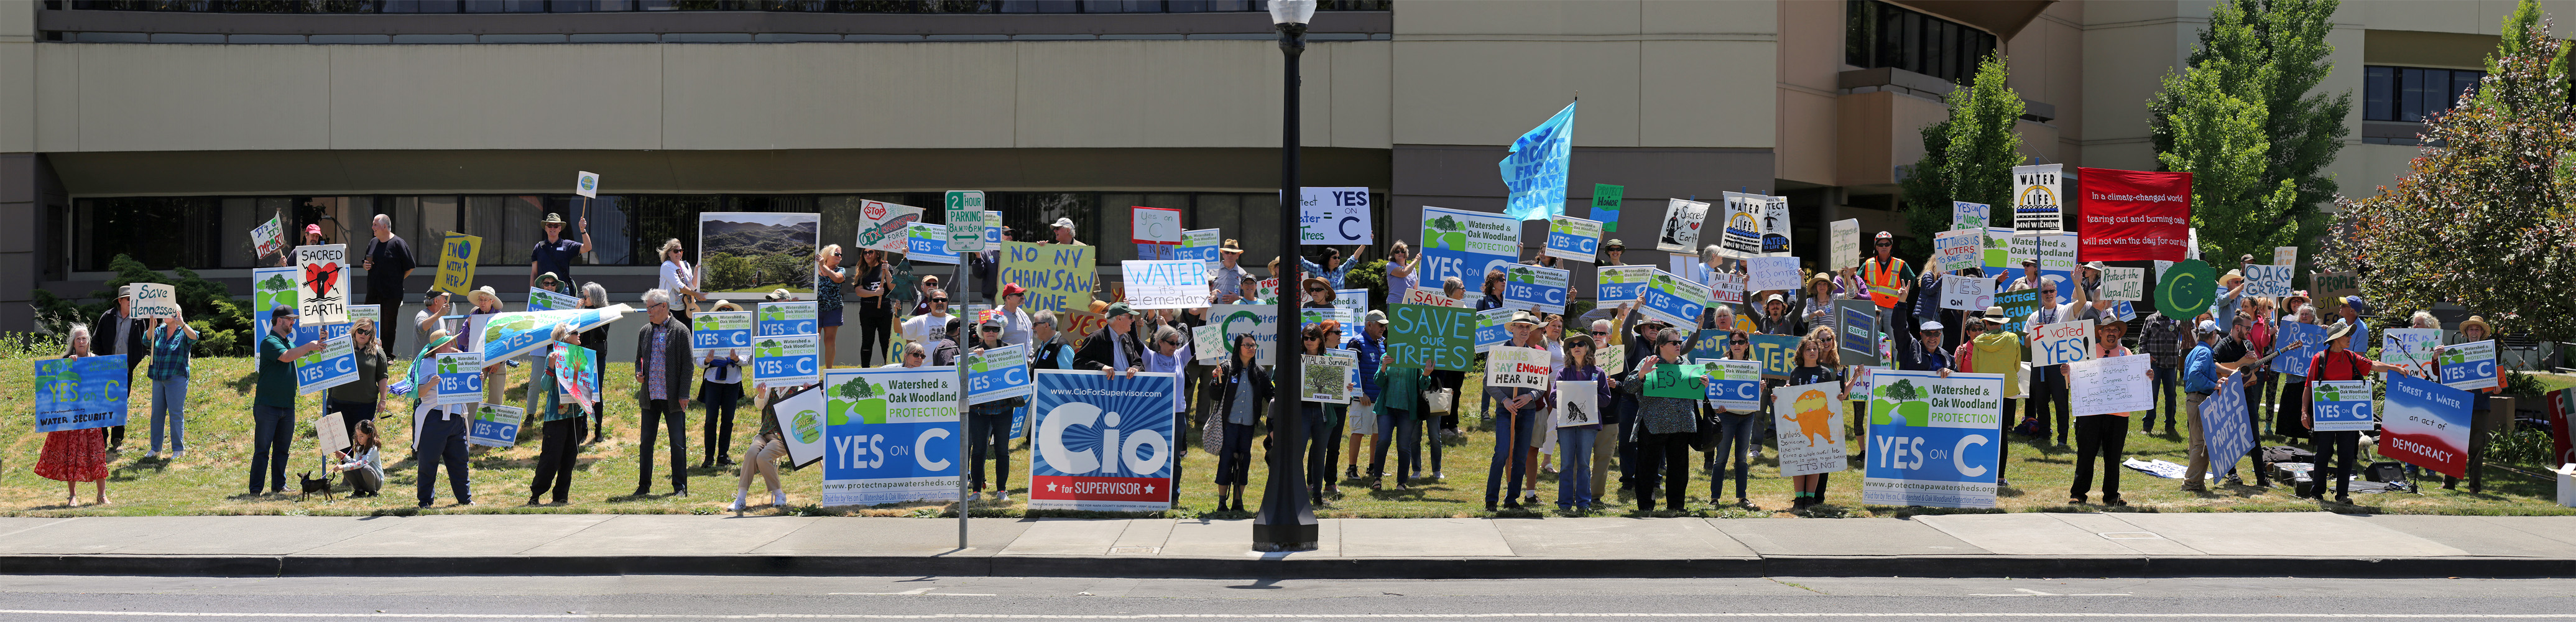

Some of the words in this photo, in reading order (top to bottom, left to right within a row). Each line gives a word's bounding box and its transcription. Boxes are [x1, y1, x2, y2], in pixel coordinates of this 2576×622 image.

[1509, 137, 1565, 165] PROFIT
[1515, 159, 1559, 180] FROM
[2020, 174, 2055, 185] WATER
[951, 196, 959, 209] 2
[964, 197, 981, 207] HOUR
[1332, 191, 1367, 207] YES
[1512, 187, 1565, 211] CHAOS
[1597, 197, 1618, 207] HONOR
[2027, 194, 2048, 205] LIFE
[2092, 192, 2099, 200] In
[2107, 193, 2166, 203] climate-changed
[2166, 195, 2183, 203] world
[866, 207, 884, 216] STOP
[1680, 206, 1706, 220] Sacred
[1730, 201, 1760, 215] WATER
[951, 211, 981, 222] PARKING
[1140, 211, 1157, 225] Yes
[2087, 215, 2115, 225] tearing
[2146, 215, 2173, 225] burning
[2174, 216, 2185, 225] oaks
[866, 228, 882, 241] TX
[881, 215, 916, 234] CHAINSAW
[1148, 222, 1163, 238] C
[1338, 216, 1362, 241] C
[1735, 218, 1752, 231] LIFE
[1300, 225, 1325, 241] Trees
[1467, 230, 1481, 238] Oak
[1482, 231, 1517, 242] Woodland
[1679, 231, 1698, 244] Earth
[1832, 225, 1858, 241] Expose
[1467, 241, 1516, 253] PROTECTION
[1832, 241, 1857, 254] Green
[1936, 238, 1948, 249] IT
[1950, 236, 1969, 246] TAKES
[1970, 236, 1980, 245] US
[2082, 237, 2097, 245] will
[2128, 236, 2141, 244] the
[2142, 236, 2156, 246] day
[2158, 236, 2168, 246] for
[302, 250, 343, 261] SACRED
[448, 242, 458, 258] I'M
[1011, 244, 1038, 263] NO
[1054, 248, 1084, 268] NV
[1944, 246, 1975, 256] VOTERS
[446, 260, 462, 272] WITH
[446, 273, 459, 287] HER
[1124, 262, 1206, 285] WATER
[2103, 268, 2126, 284] Protect
[2128, 268, 2139, 279] the
[2245, 265, 2291, 283] OAKS
[1757, 279, 1773, 289] YES
[1789, 276, 1798, 286] C
[1947, 276, 1982, 295] YES
[2245, 282, 2291, 297] GRAPES
[2317, 274, 2357, 294] PEOPLE
[139, 284, 167, 299] Save
[1128, 288, 1209, 307] elementary
[1510, 284, 1533, 299] YES
[1544, 288, 1561, 304] C
[2102, 284, 2121, 300] Napa
[2122, 281, 2141, 299] Hills
[1414, 291, 1454, 307] SAVE
[1648, 290, 1671, 309] YES
[1681, 304, 1699, 320] C
[1994, 292, 2036, 305] PROTEGE
[130, 299, 177, 318] Hennessey
[304, 304, 343, 317] EARTH
[1393, 307, 1472, 340] SAVE
[1847, 310, 1871, 323] CLIMATE
[1847, 318, 1870, 330] SCIENCE
[1849, 327, 1867, 337] SAVES
[2033, 325, 2044, 341] I
[2050, 322, 2084, 338] voted
[1420, 335, 1447, 347] OUR
[1845, 341, 1870, 353] FORESTS
[1388, 342, 1467, 369] TREES
[1494, 350, 1528, 361] NAPNS
[2041, 336, 2090, 365] YES!
[758, 360, 783, 374] YES
[795, 357, 813, 374] C
[1493, 363, 1513, 373] SAY
[1517, 363, 1548, 376] ENOUGH
[2079, 369, 2098, 379] Jason
[2102, 364, 2130, 376] Kishineff
[2444, 366, 2466, 381] YES
[2477, 361, 2493, 377] C
[889, 378, 939, 390] Watershed
[941, 381, 948, 389] &
[2102, 376, 2122, 385] Congress
[48, 383, 78, 403] YES
[83, 392, 96, 401] on
[104, 380, 120, 402] C
[1050, 388, 1162, 397] www.CioForSupervisor.com
[1709, 383, 1724, 396] ES
[1737, 383, 1755, 399] C
[1932, 384, 1981, 396] Watershed
[2398, 381, 2423, 397] FOREST
[2426, 392, 2432, 401] &
[2436, 393, 2460, 409] WATER
[889, 392, 908, 404] Oak
[908, 391, 957, 402] Woodland
[1931, 397, 1949, 408] Oak
[1951, 398, 1997, 409] Woodland
[889, 407, 957, 418] PROTECTION
[2203, 381, 2240, 434] TREES
[2317, 404, 2340, 418] YES
[2352, 402, 2368, 419] C
[40, 417, 68, 426] WATER
[73, 412, 114, 424] SECURITY
[1931, 412, 1996, 424] PROTECTION
[2421, 418, 2434, 426] act
[794, 421, 821, 435] Watersheds
[2212, 405, 2245, 455] PROTECT
[1038, 402, 1168, 475] Cio
[833, 434, 884, 470] YES
[890, 445, 908, 456] ON
[914, 427, 952, 471] C
[1876, 435, 1925, 470] YES
[1929, 449, 1947, 460] ON
[1953, 434, 1989, 477] C
[2215, 423, 2251, 477] WATER
[2392, 437, 2453, 463] DEMOCRACY
[825, 478, 960, 490] www.protectnapawatersheds.org
[1061, 484, 1073, 494] for
[1074, 481, 1140, 495] SUPERVISOR
[1865, 481, 1995, 494] www.protectnapawatersheds.org
